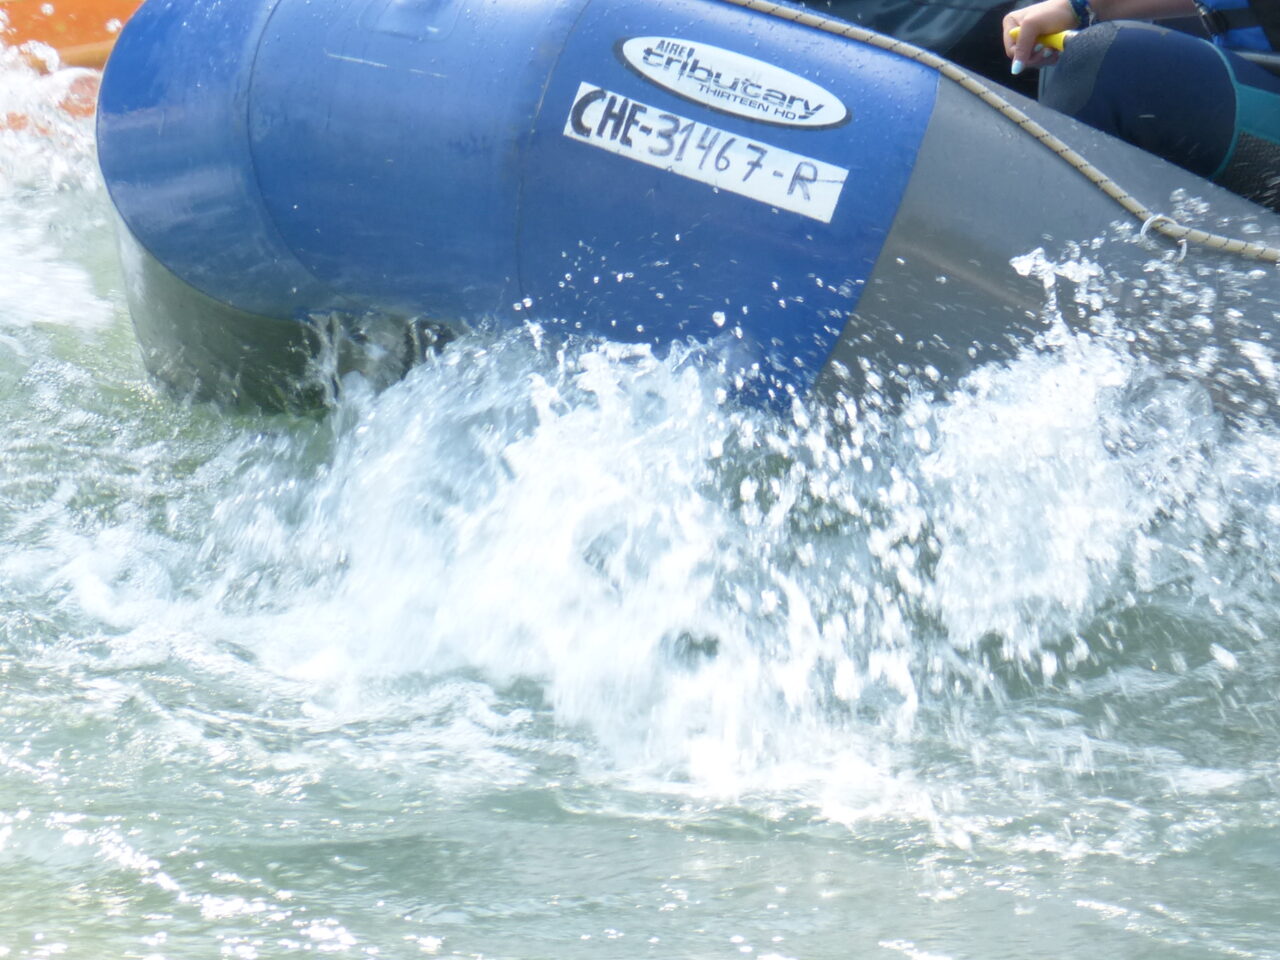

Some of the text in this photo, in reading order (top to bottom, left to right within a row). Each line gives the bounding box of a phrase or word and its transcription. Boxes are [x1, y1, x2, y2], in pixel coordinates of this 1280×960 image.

[656, 40, 687, 57] AIRE
[642, 46, 825, 120] tributary
[699, 83, 797, 121] THIRTEEN HD
